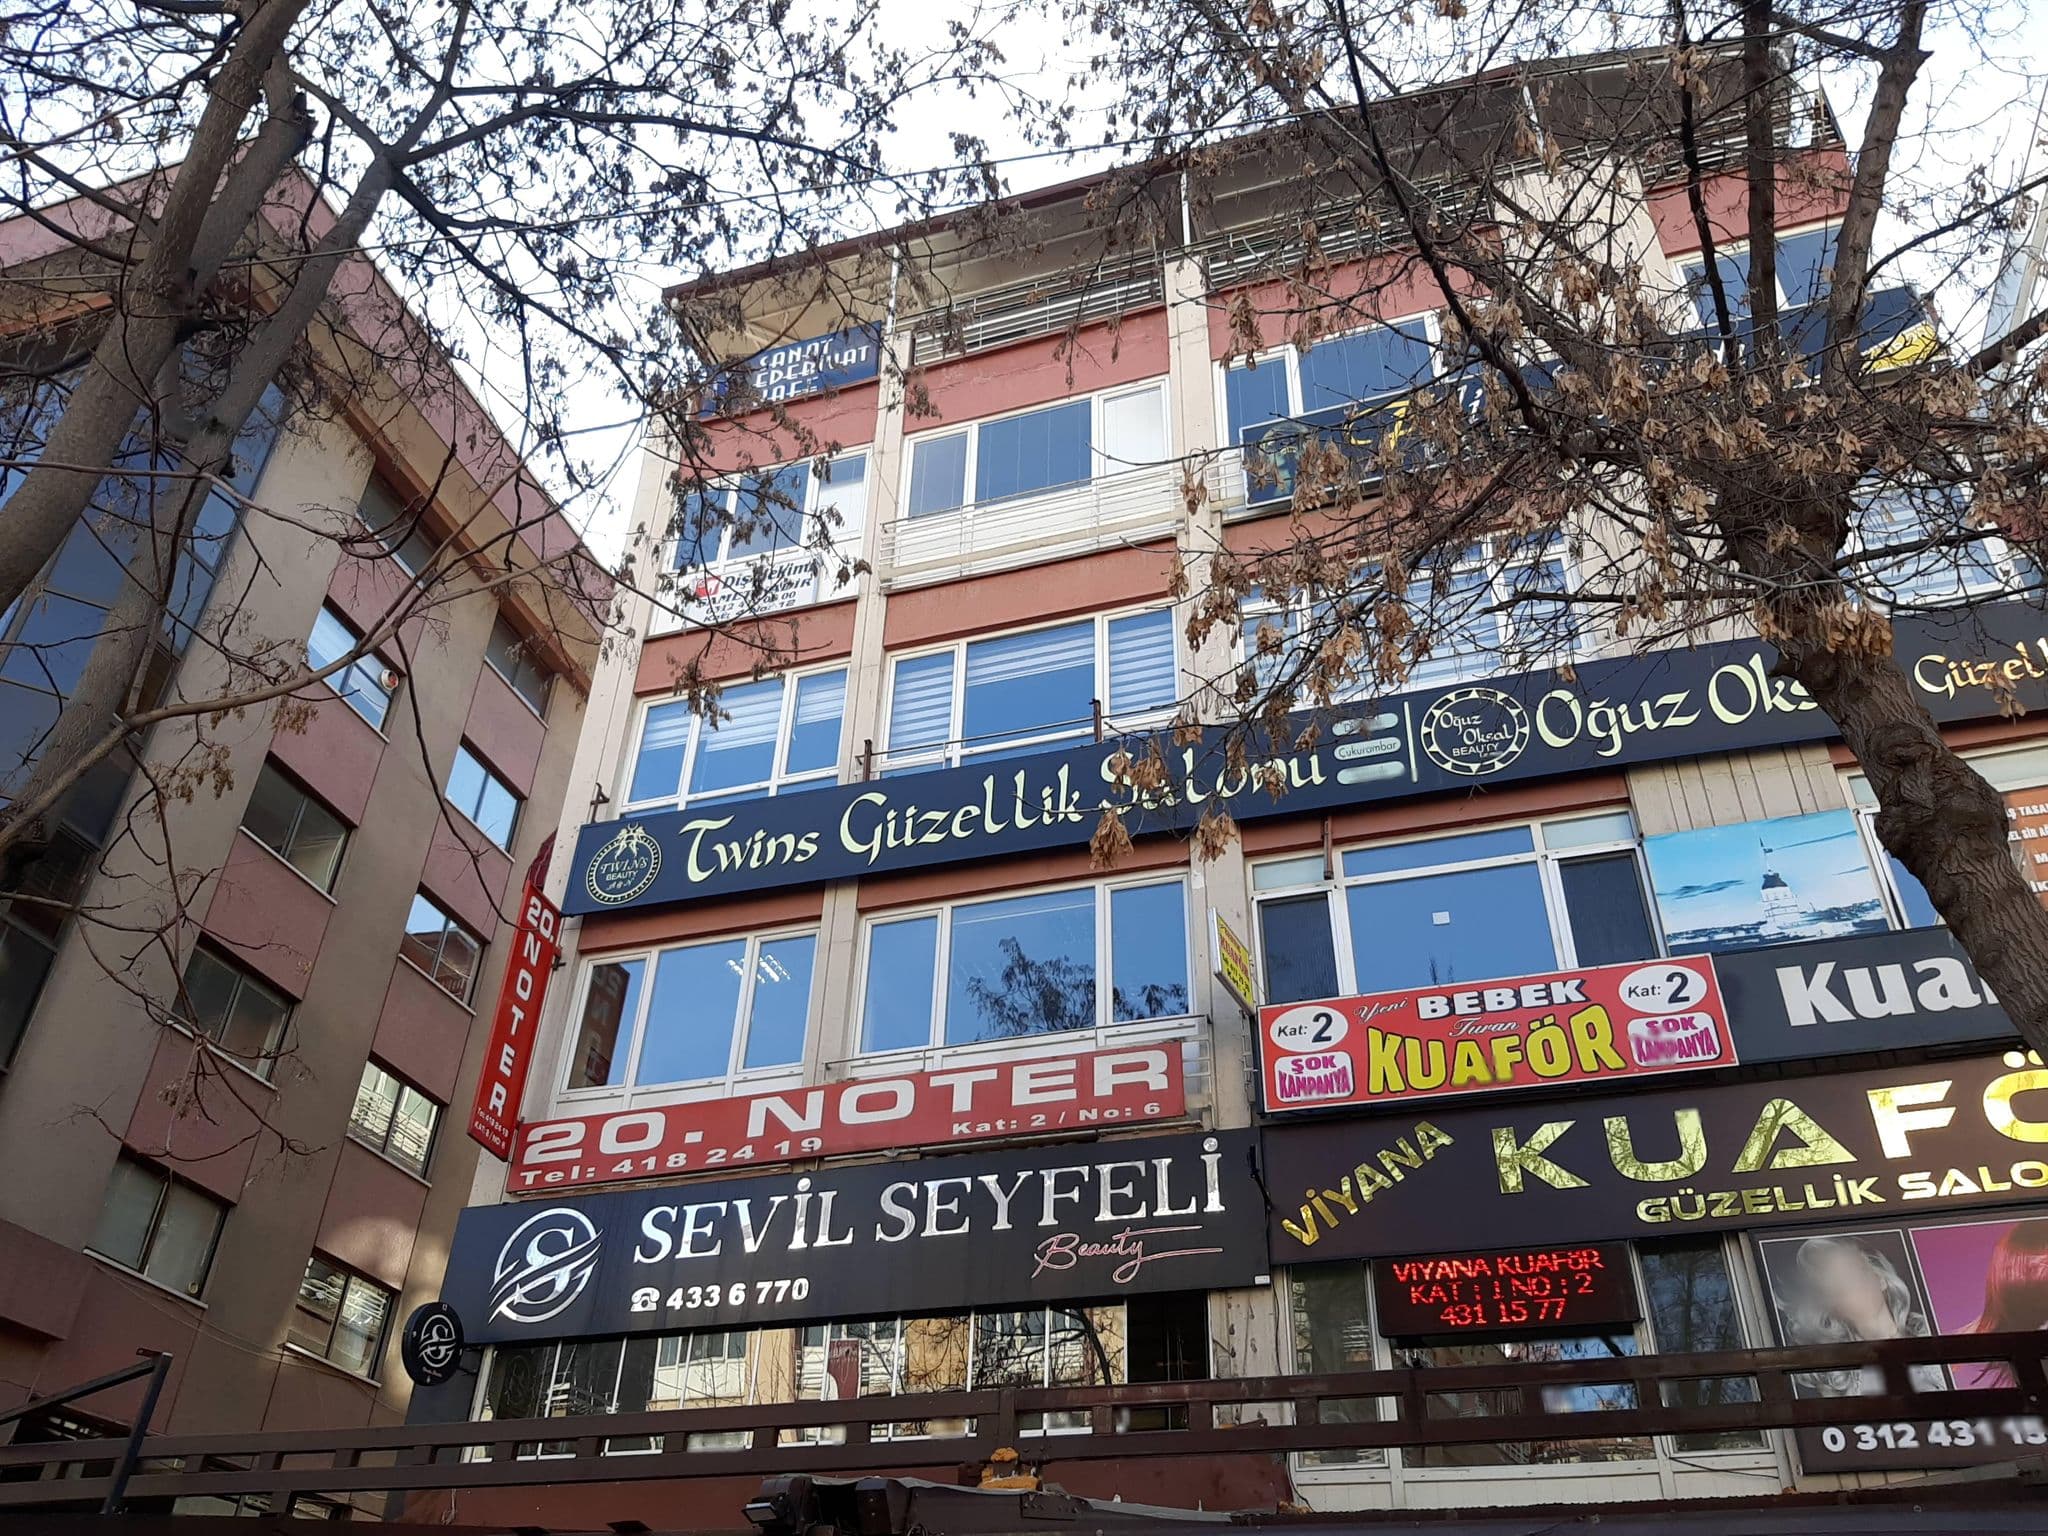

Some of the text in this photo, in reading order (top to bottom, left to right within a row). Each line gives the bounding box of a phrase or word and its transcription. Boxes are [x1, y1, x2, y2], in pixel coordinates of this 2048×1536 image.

[1440, 712, 1482, 735] Oğuz
[1463, 724, 1513, 745] Oksal
[1535, 688, 1700, 758] Oğuz
[1452, 743, 1499, 757] BEAUTY
[679, 815, 820, 884] Twins
[840, 765, 1084, 867] Güzellik
[526, 895, 555, 943] 20.
[1417, 978, 1593, 1020] BEBEK
[1628, 971, 1690, 1004] Kat: 2
[1775, 957, 2000, 1027] Kua
[488, 929, 543, 1118] NOTER
[1277, 1012, 1333, 1043] Kat: 2
[1449, 1016, 1520, 1038] Turan
[1367, 1003, 1628, 1096] KUAFÖR
[1633, 1027, 1718, 1063] KAANYA
[1290, 1055, 1337, 1075] ŞOK
[523, 1049, 1169, 1166] 20. NOTER
[952, 1118, 1018, 1137] Kat:
[1030, 1113, 1047, 1128] 2
[1078, 1104, 1133, 1121] No:
[1143, 1102, 1161, 1115] 6
[520, 1136, 823, 1186] Tel: 418 24 19
[631, 1137, 1227, 1267] SEVİL SEYFELİ
[1281, 1120, 1456, 1246] VİYANA
[1636, 1160, 2048, 1223] GÜZELLİK SALO
[1030, 1222, 1224, 1285] Beauty
[666, 1277, 812, 1311] 433 6 770
[1574, 1273, 1594, 1294] 2
[1440, 1298, 1566, 1326] 431 15 77
[1822, 1427, 1846, 1453] 0
[1853, 1422, 1919, 1450] 312
[1928, 1419, 1995, 1447] 431
